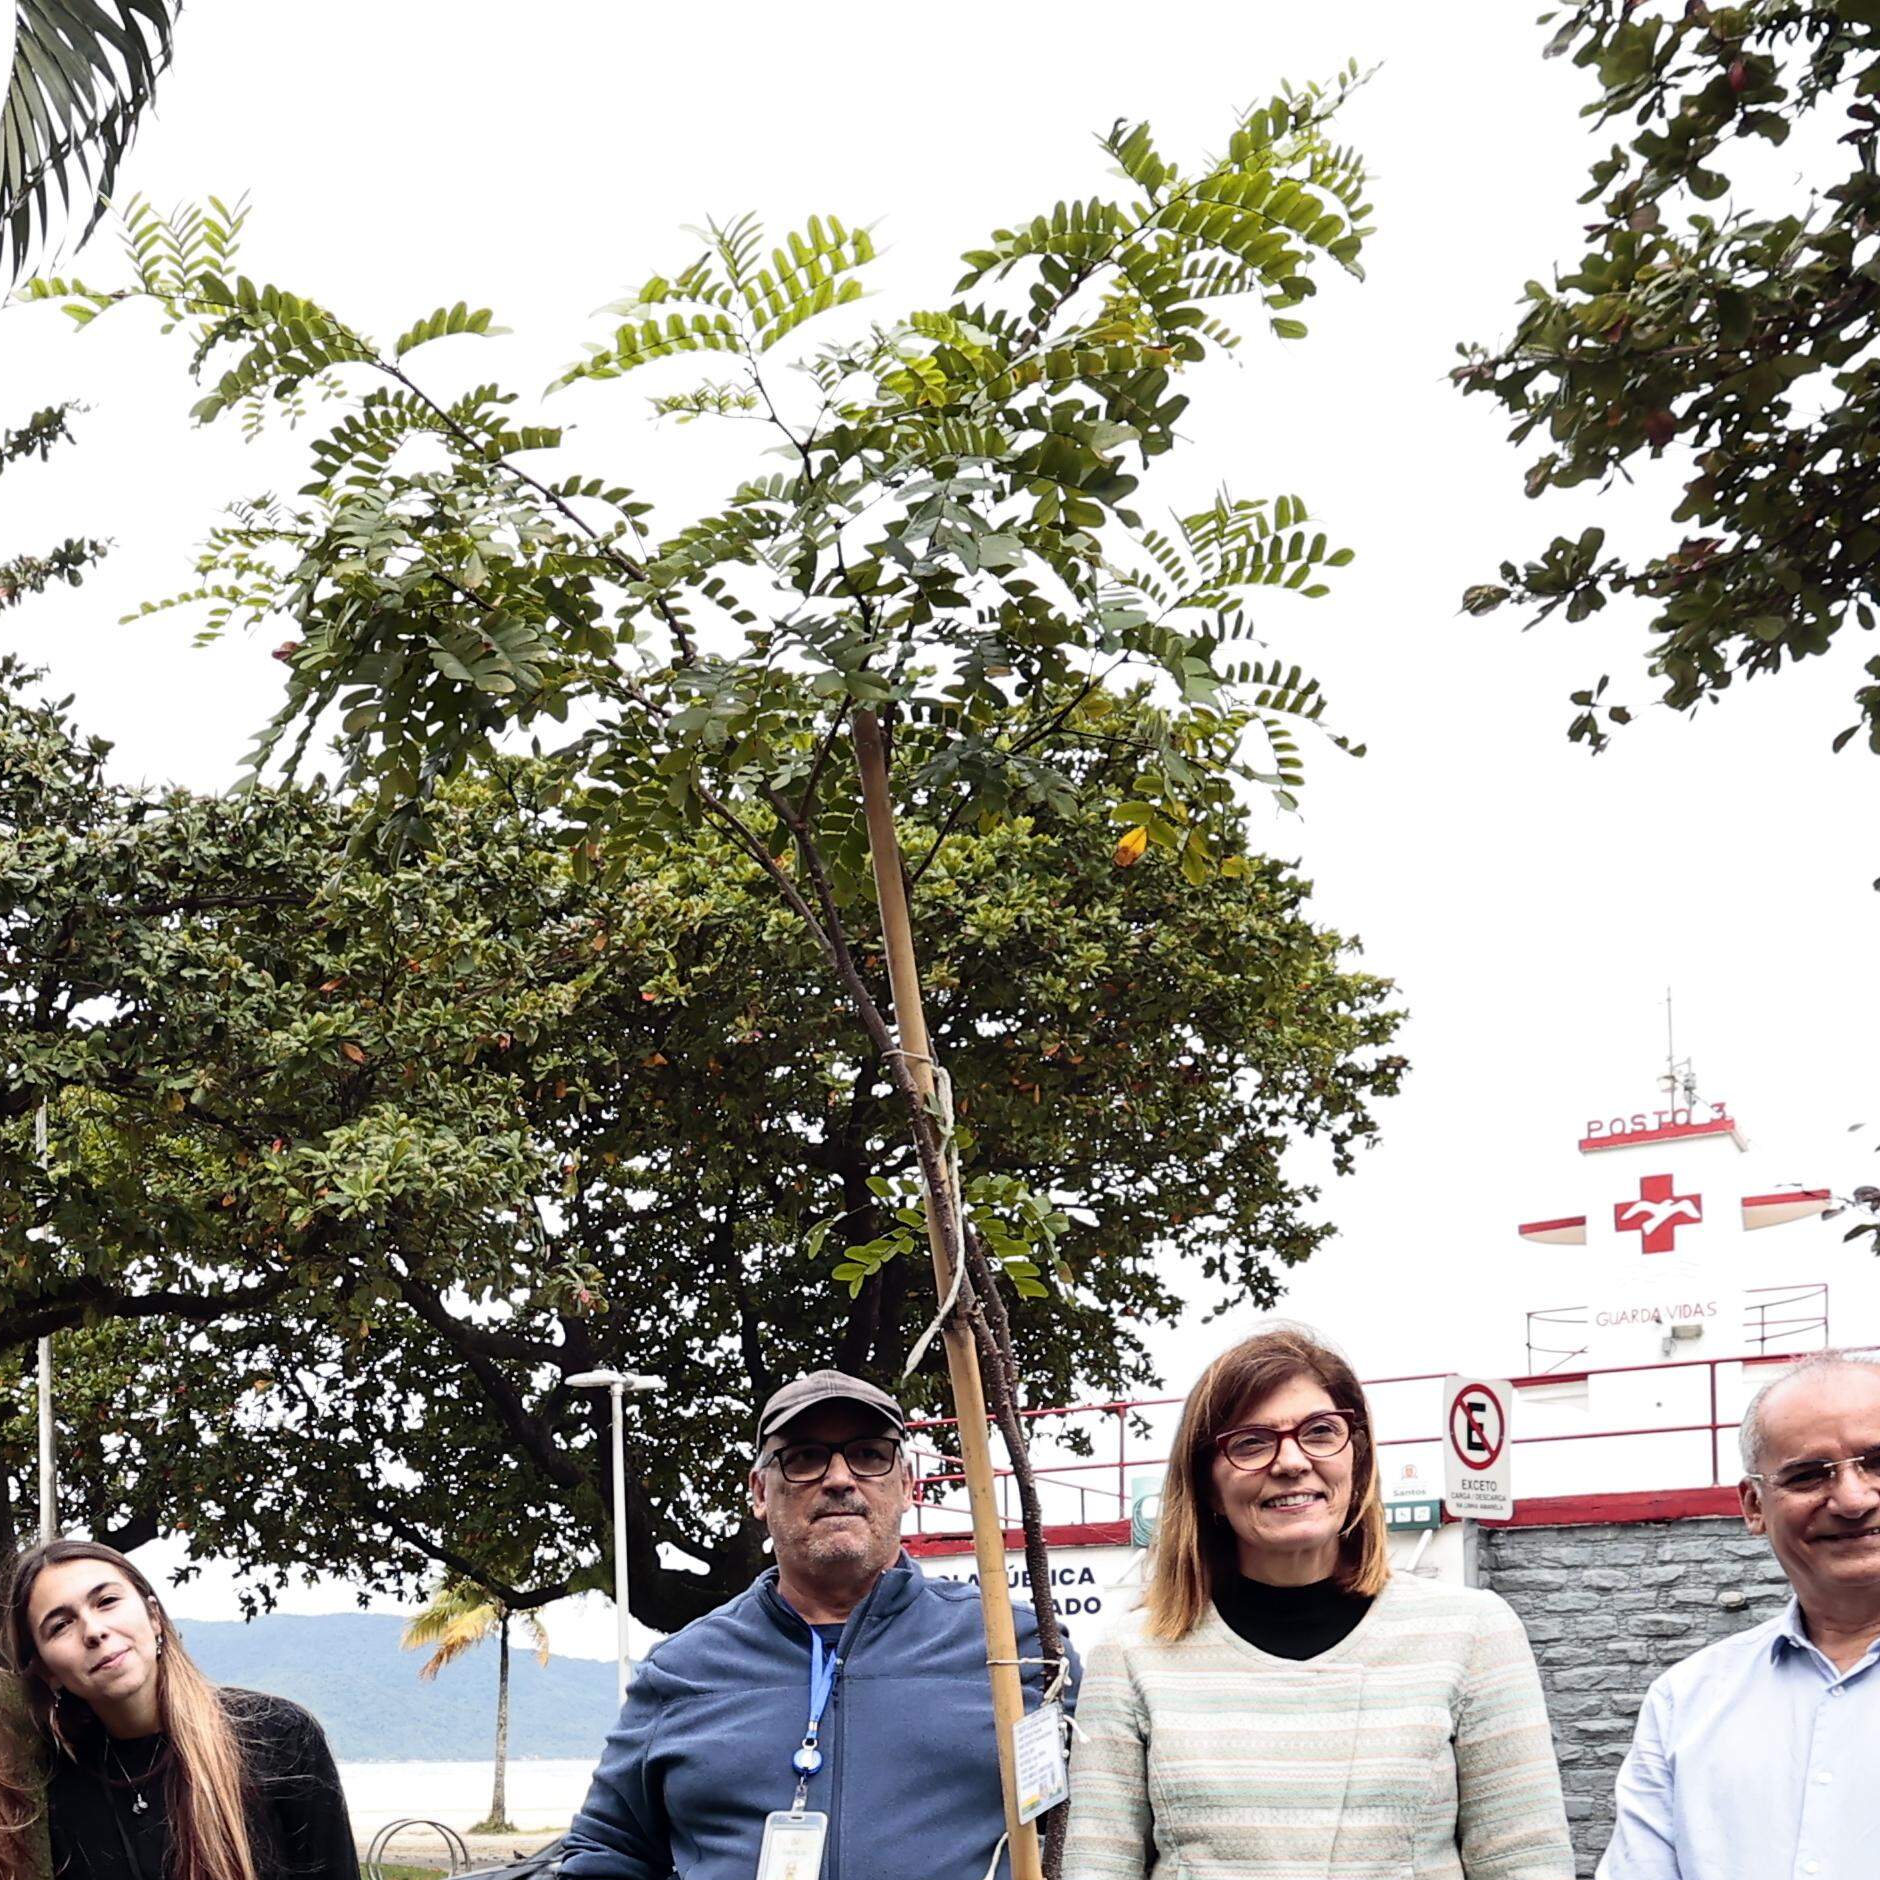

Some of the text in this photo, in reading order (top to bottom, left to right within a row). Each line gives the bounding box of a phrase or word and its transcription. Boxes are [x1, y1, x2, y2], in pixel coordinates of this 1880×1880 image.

[1587, 1102, 1726, 1138] POSTO 3
[1596, 1301, 1718, 1327] GUARDA VIDAS
[1393, 1489, 1427, 1497] Santos
[1461, 1479, 1498, 1491] EXCETO
[1008, 1565, 1096, 1589] ÚBICA
